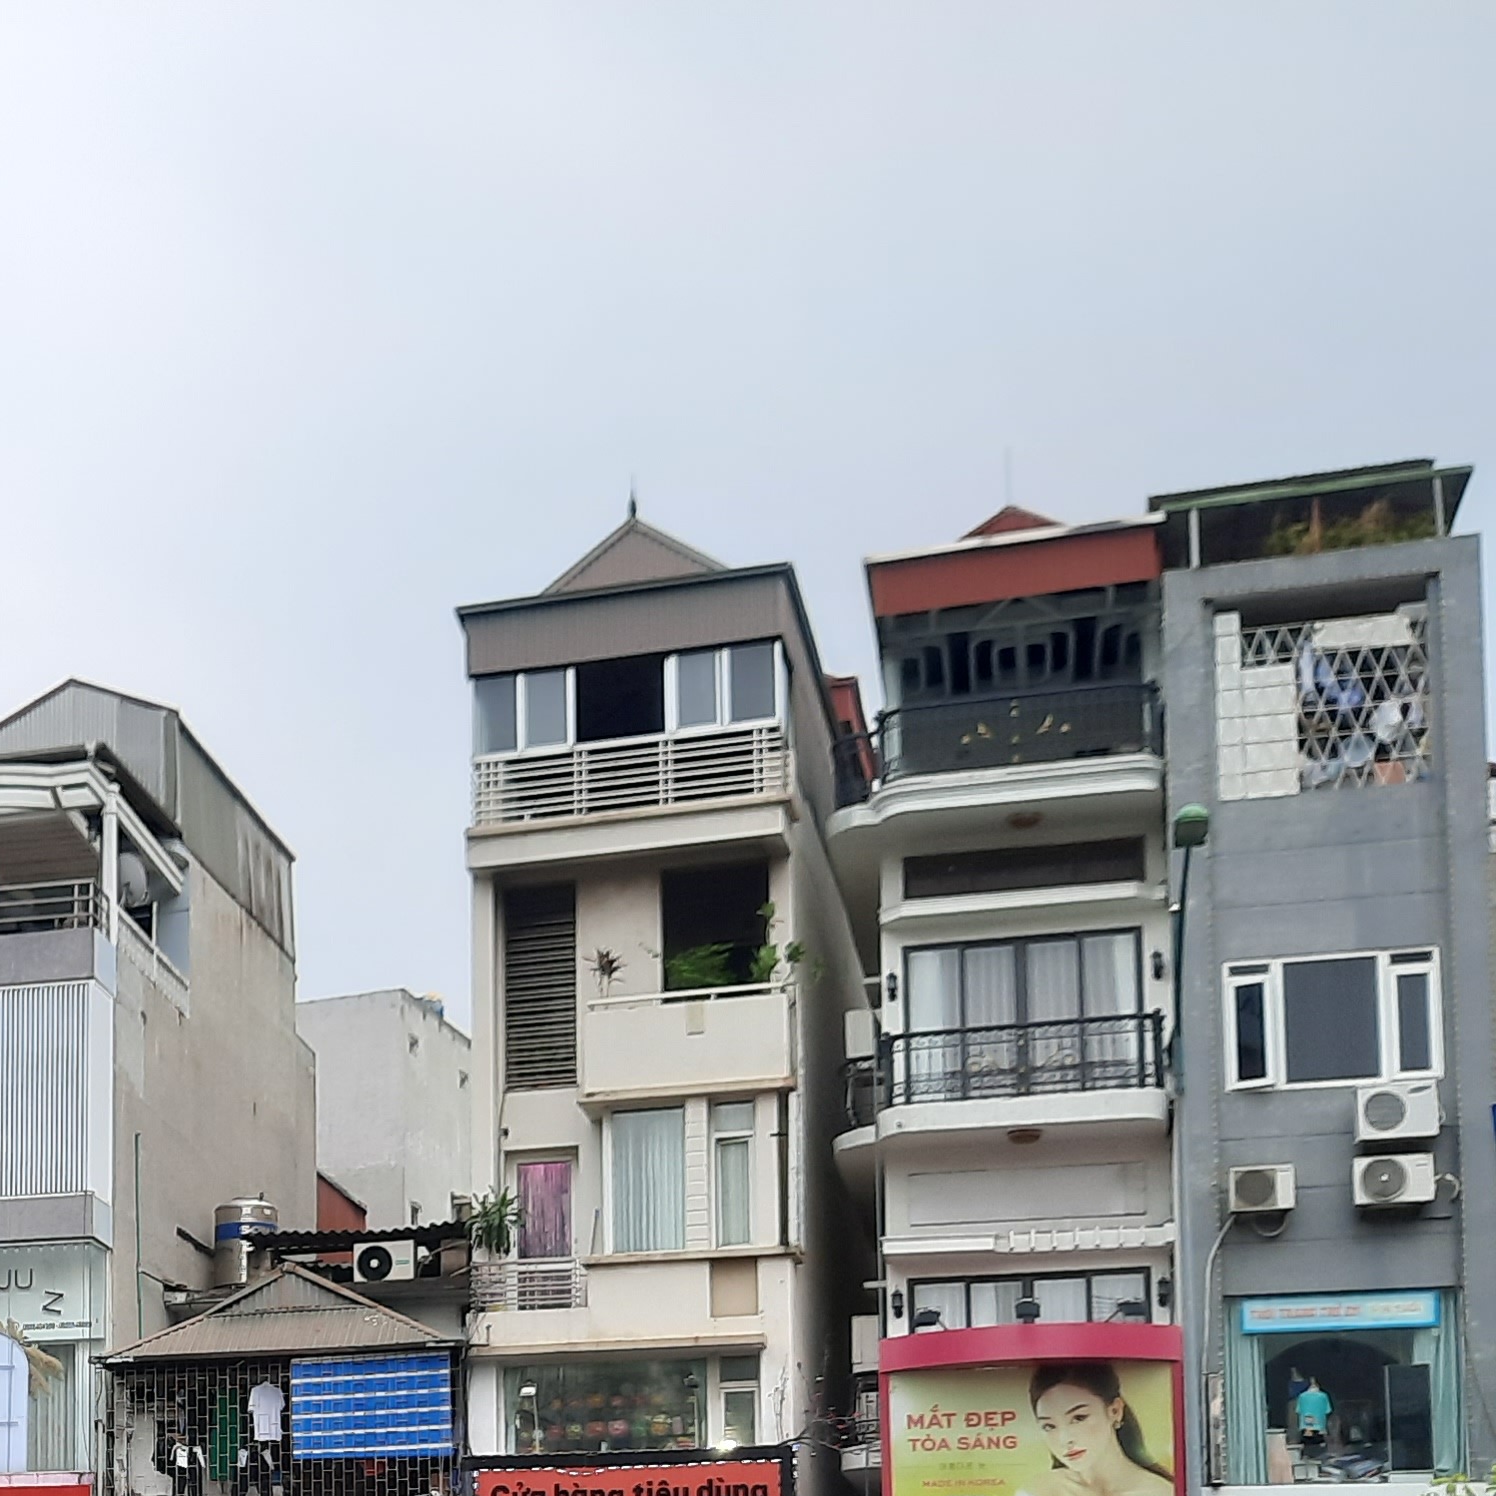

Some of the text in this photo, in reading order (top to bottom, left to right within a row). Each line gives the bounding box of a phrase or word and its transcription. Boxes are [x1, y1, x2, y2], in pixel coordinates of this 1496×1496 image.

[907, 1404, 1017, 1431] MẮT ĐẸP
[957, 1432, 1018, 1450] SÁNG
